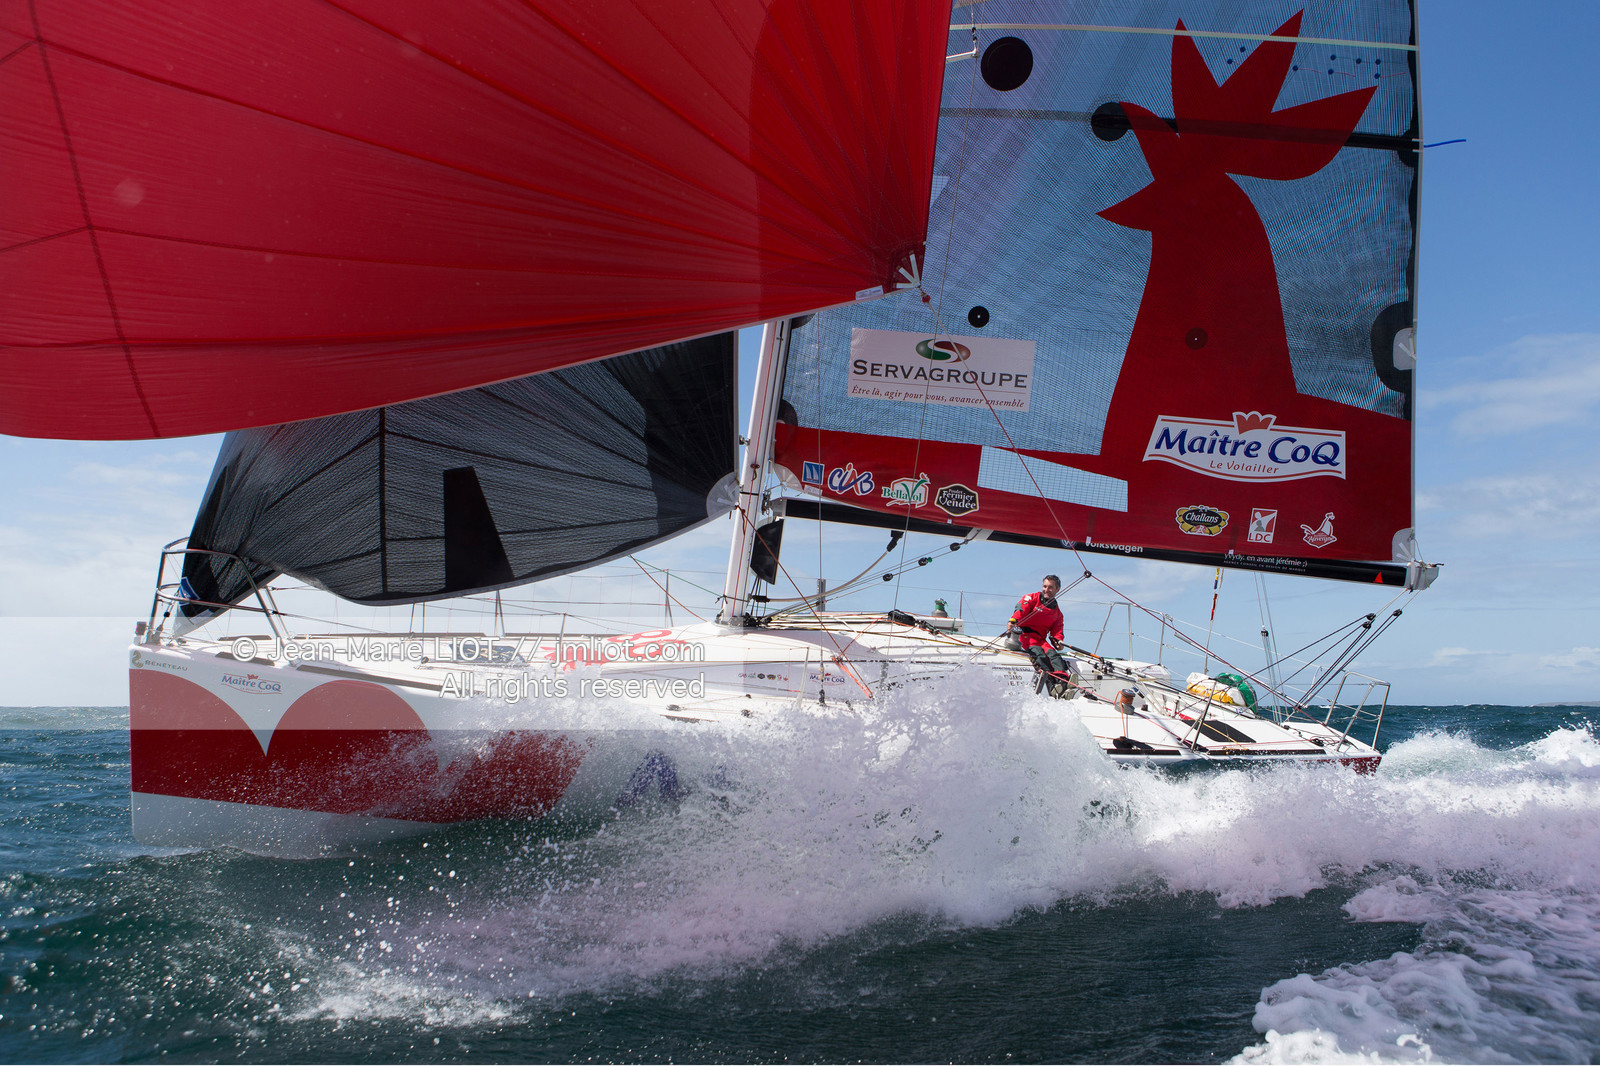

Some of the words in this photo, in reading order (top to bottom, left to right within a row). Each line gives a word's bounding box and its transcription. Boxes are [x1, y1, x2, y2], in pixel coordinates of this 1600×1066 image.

[852, 359, 1028, 389] SERVAGROUPE
[851, 385, 870, 395] Être
[871, 385, 883, 397] là,
[884, 389, 902, 400] agir
[903, 392, 924, 401] pour
[926, 393, 947, 402] vous,
[949, 396, 984, 404] avancer
[985, 397, 1025, 408] ensemble
[1154, 426, 1262, 459] Maître
[1268, 436, 1341, 467] CoQ
[1209, 460, 1223, 470] Le
[1227, 460, 1279, 474] Volailler
[939, 495, 977, 509] Vendée
[942, 490, 975, 501] Fermier
[1185, 512, 1219, 524] Challans
[1249, 532, 1271, 542] LDC
[221, 675, 256, 688] Maître
[257, 681, 281, 692] CoQ
